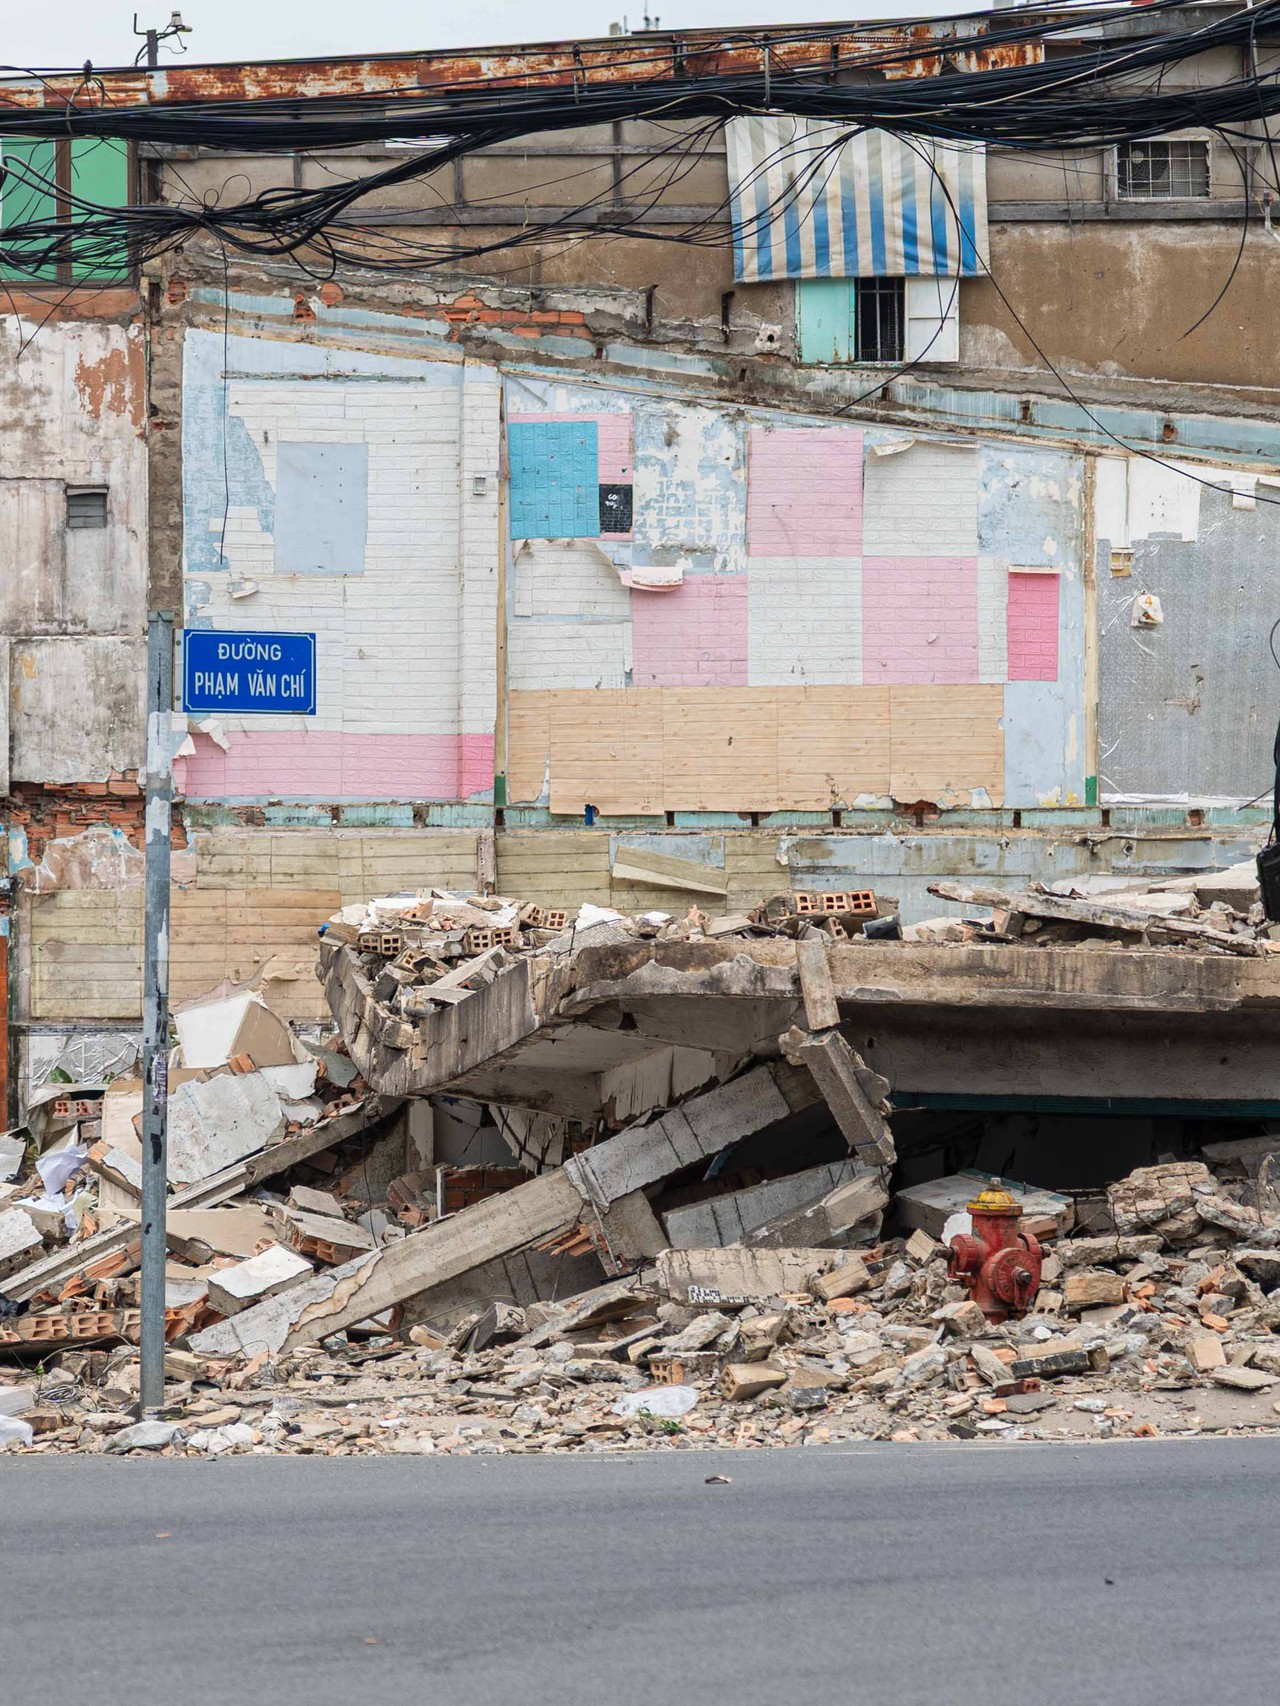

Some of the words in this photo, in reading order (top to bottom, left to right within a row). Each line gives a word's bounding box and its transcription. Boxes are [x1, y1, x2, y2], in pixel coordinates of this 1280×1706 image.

[218, 638, 281, 660] ĐƯỜNG
[195, 672, 238, 699] PHẠM
[248, 669, 276, 697] VĂN
[281, 669, 306, 698] CHÍ
